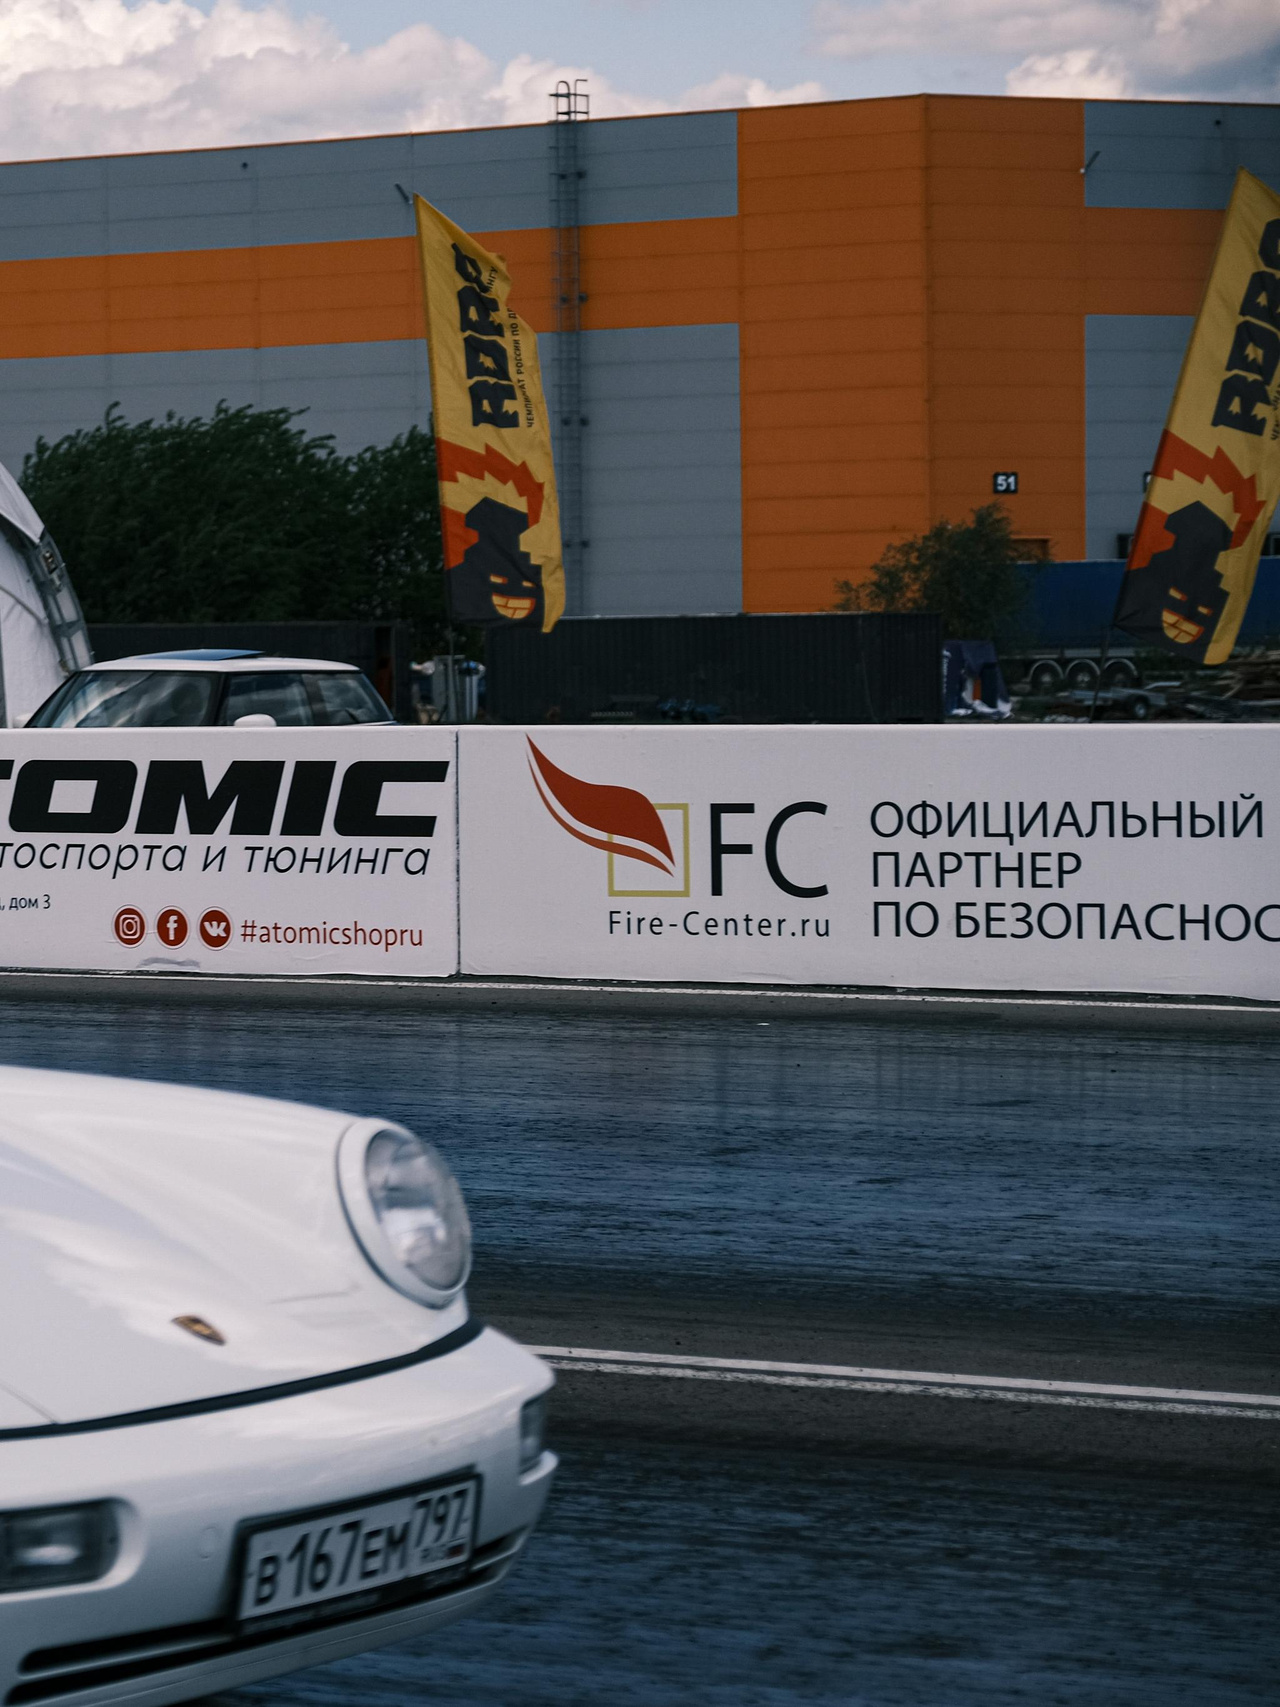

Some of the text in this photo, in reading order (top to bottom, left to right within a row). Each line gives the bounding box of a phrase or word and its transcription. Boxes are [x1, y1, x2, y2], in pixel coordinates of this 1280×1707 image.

[451, 243, 520, 428] RDRC
[996, 475, 1017, 491] 51
[870, 793, 1264, 846] ОФИЦИАЛЬНЫЙ
[202, 846, 227, 872] и
[243, 846, 431, 875] тюнинга
[710, 801, 829, 899] FC
[872, 852, 1082, 889] ПАРТНЕР
[9, 898, 39, 910] дом
[42, 894, 51, 909] 3
[241, 919, 423, 953] #atomicshopru
[609, 910, 830, 937] Fire-Center.ru
[874, 901, 1280, 942] ПО БЕЗОПАСНОС
[415, 1487, 468, 1548] 797
